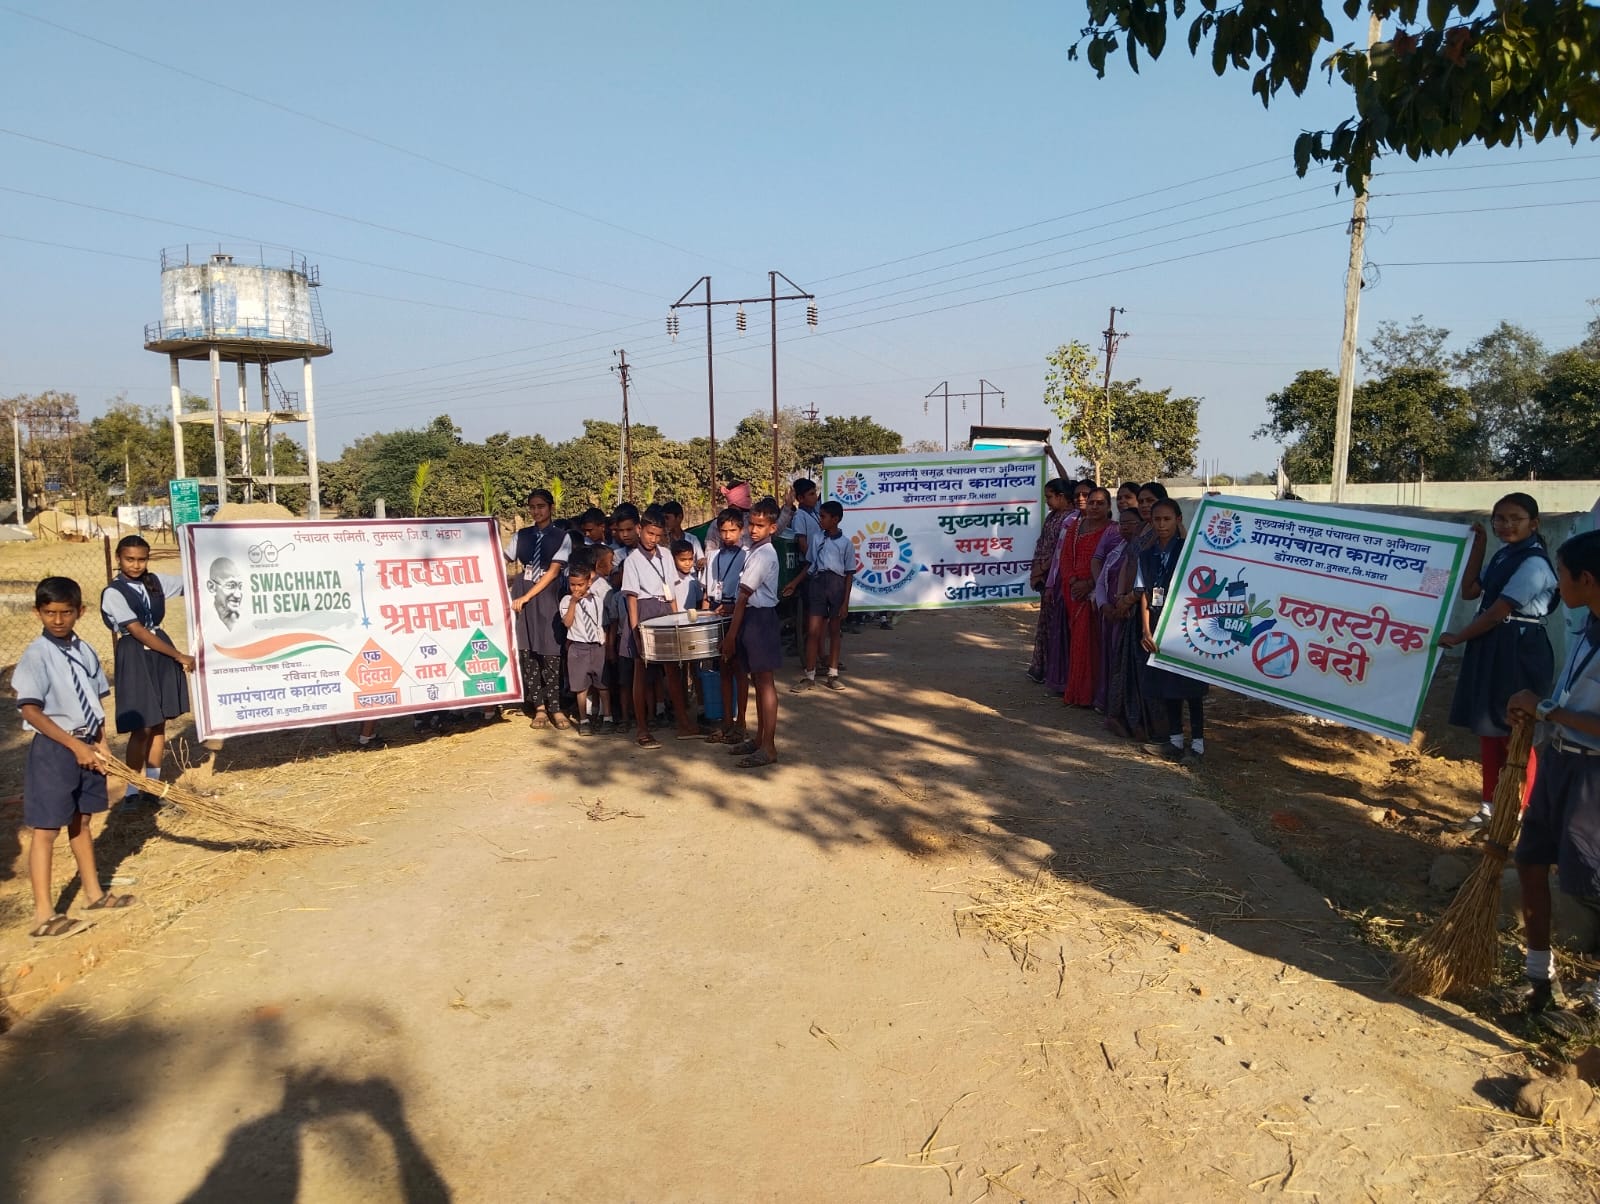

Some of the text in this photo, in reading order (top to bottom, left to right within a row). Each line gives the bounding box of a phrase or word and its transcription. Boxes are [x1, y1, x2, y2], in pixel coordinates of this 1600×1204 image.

[947, 466, 976, 475] पंचायत
[979, 466, 996, 474] राज
[998, 463, 1036, 474] अभियान
[878, 477, 963, 495] ग्रामपंचायत
[969, 473, 1036, 490] कार्यालय
[938, 506, 1031, 534] मुख्यमंत्री
[294, 532, 330, 544] पंचायत
[373, 531, 404, 546] तुमसर
[436, 526, 462, 540] भंडारा
[1254, 517, 1295, 532] मुख्यमंत्री
[1326, 527, 1361, 542] पंचायत
[1363, 535, 1382, 546] राज
[1386, 537, 1431, 554] अभियान
[1250, 531, 1343, 559] ग्रामपंचायत
[1346, 546, 1427, 573] कार्यालय
[250, 570, 342, 593] SWACHHATA
[375, 556, 483, 590] स्वच्छता
[945, 582, 1025, 601] अभियान
[252, 592, 351, 614] HI SEVA 2026
[1200, 602, 1245, 616] PLASTIC
[379, 598, 494, 635] श्रमदान
[1223, 618, 1247, 633] BAN
[1278, 596, 1430, 652] प्लास्टीक
[420, 645, 438, 659] एक
[472, 639, 488, 653] एक
[363, 650, 381, 664] एक
[465, 655, 500, 674] सोबत
[1308, 636, 1370, 683] बंदी
[282, 671, 317, 681] रविवार
[358, 666, 392, 684] दिवस
[415, 663, 447, 680] तास
[217, 680, 341, 706] ग्रामपंचायत कार्यालय
